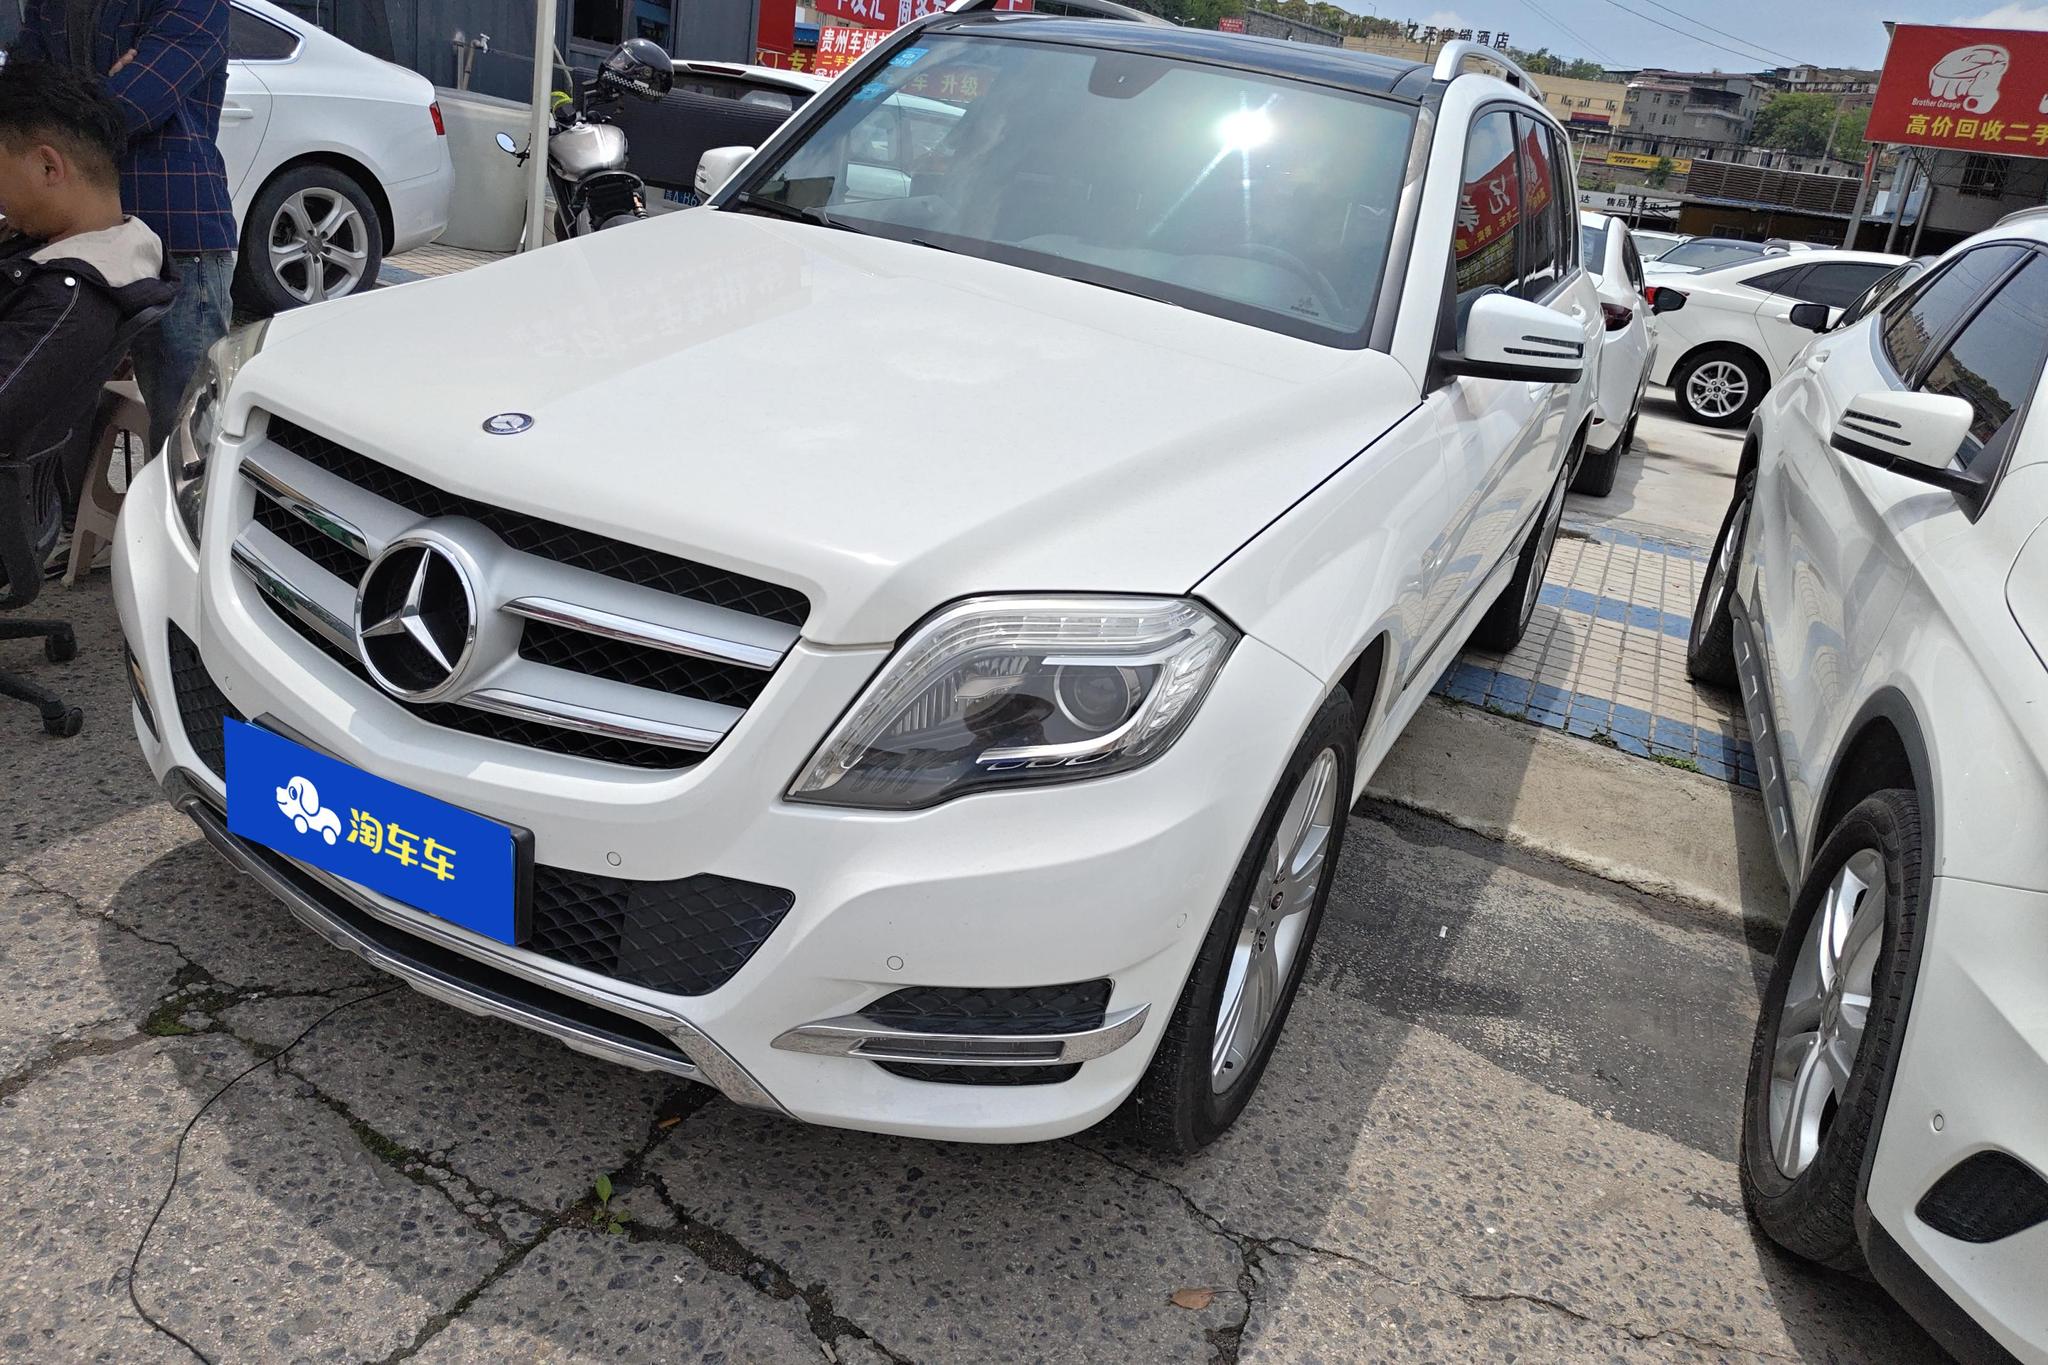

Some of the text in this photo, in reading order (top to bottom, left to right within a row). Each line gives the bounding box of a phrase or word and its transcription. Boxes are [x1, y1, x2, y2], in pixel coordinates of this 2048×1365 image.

[820, 28, 889, 55] 贵州车域
[1911, 97, 1962, 110] Brother Garage
